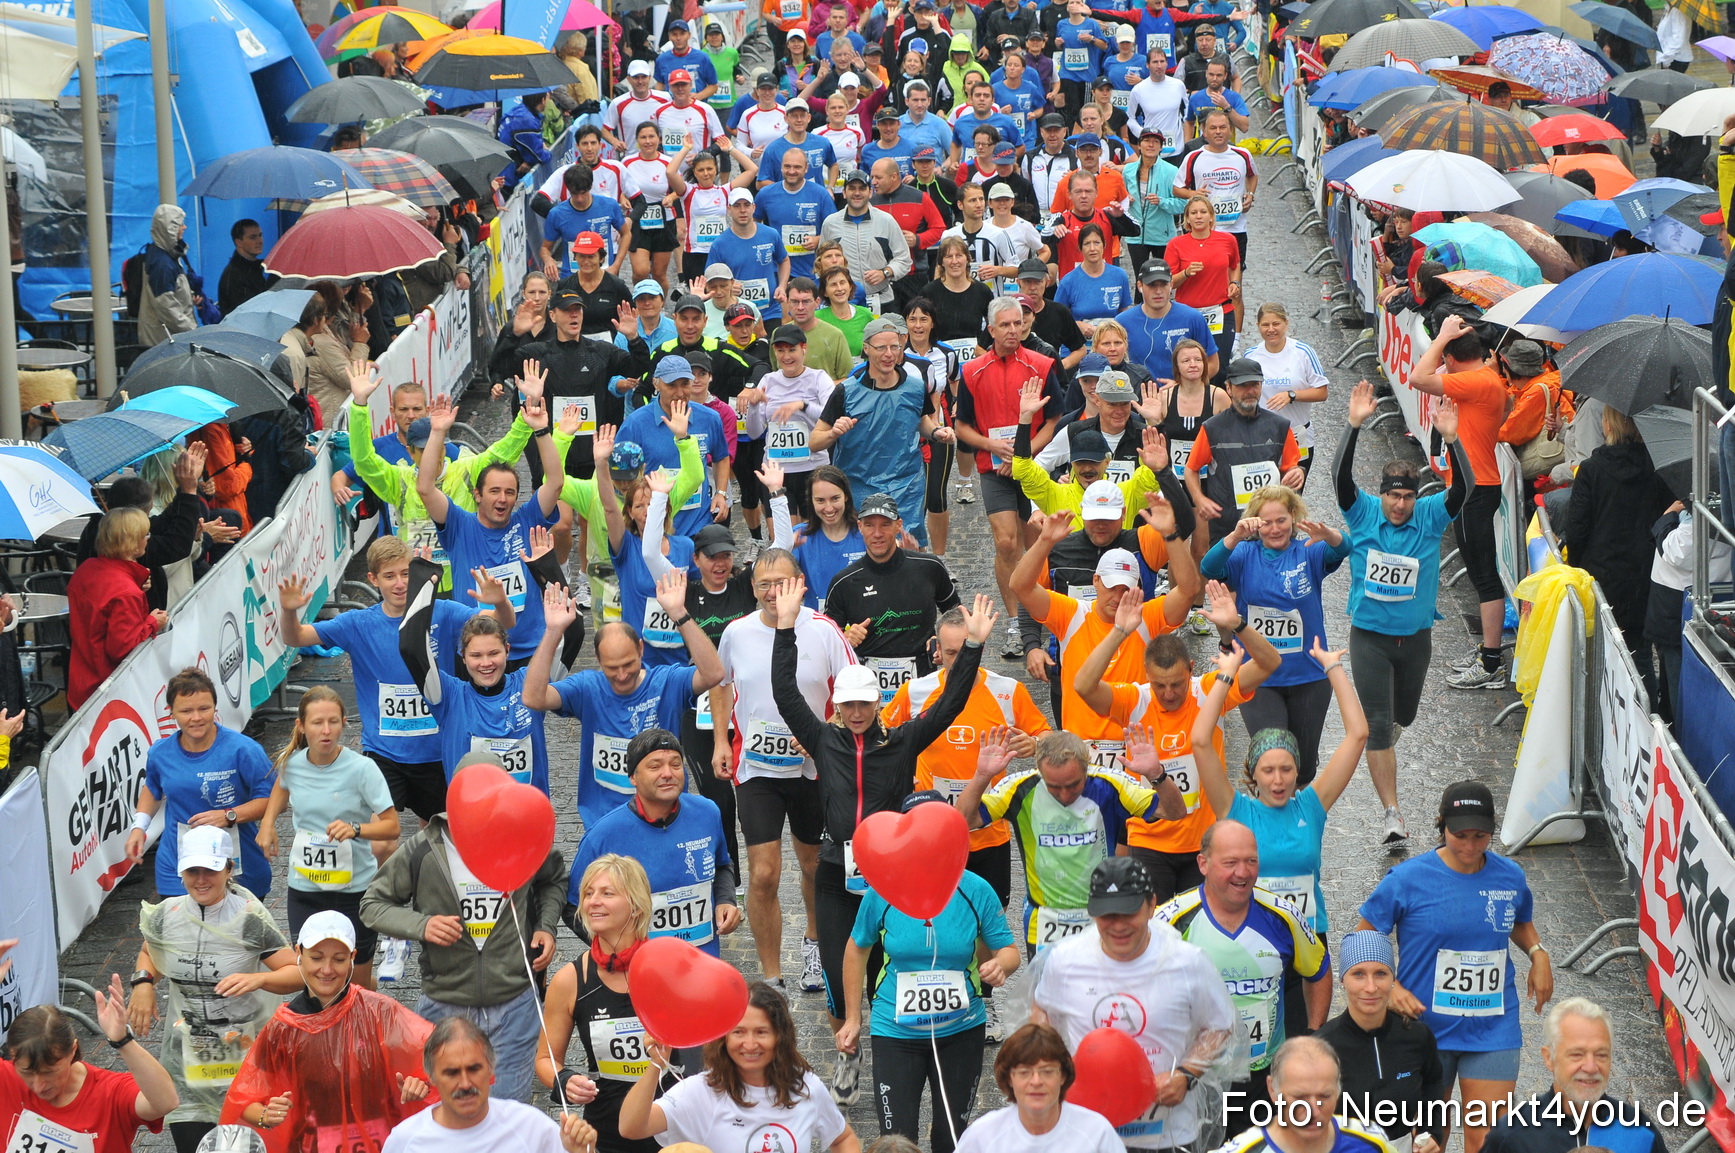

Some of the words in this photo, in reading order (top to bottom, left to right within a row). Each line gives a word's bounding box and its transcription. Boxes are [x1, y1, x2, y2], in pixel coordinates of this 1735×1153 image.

[1067, 53, 1086, 62] 2831
[1112, 96, 1128, 107] 283
[665, 134, 685, 145] 268
[1214, 202, 1240, 214] 3232
[699, 223, 724, 235] 2679
[740, 287, 766, 302] 2924
[772, 430, 805, 447] 2910
[1243, 473, 1271, 492] 692
[1369, 564, 1412, 585] 2267
[1376, 586, 1399, 595] Martin
[1254, 618, 1298, 637] 2876
[220, 640, 243, 678] NISSAN
[877, 670, 911, 690] 646
[384, 697, 432, 718] 3416
[1040, 822, 1079, 832] TEAM
[1038, 830, 1098, 848] BOCK
[303, 846, 337, 869] 541
[309, 871, 330, 883] Heidi
[460, 897, 503, 921] 657
[654, 899, 707, 930] 3017
[1225, 976, 1274, 996] OCK
[1443, 967, 1501, 993] 2519
[903, 988, 963, 1013] 2895
[1449, 995, 1491, 1008] Christine
[882, 1095, 893, 1130] odlo
[39, 1124, 72, 1142] BOCK
